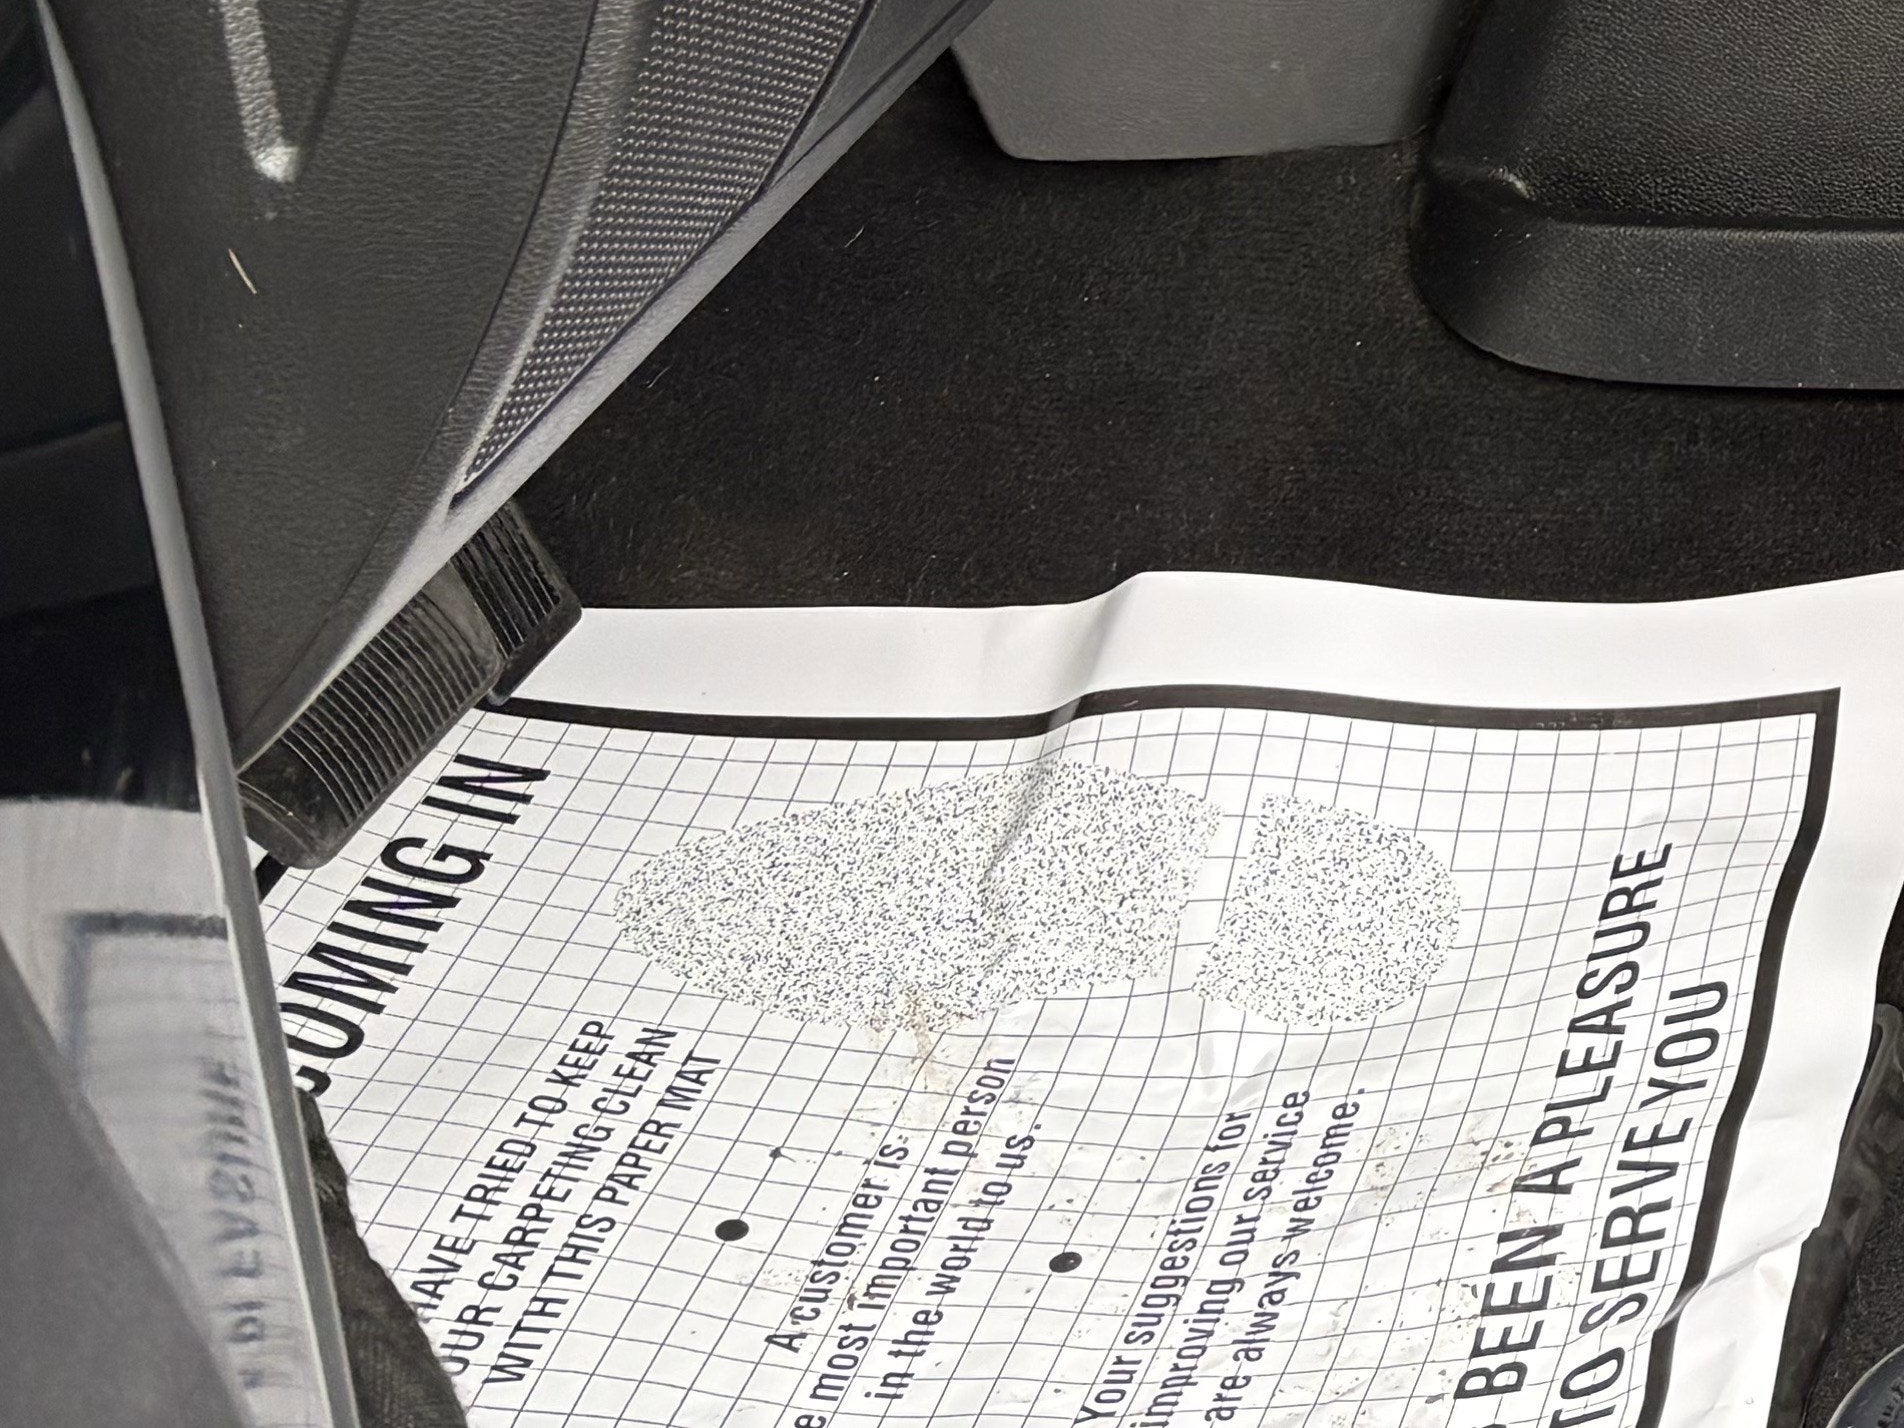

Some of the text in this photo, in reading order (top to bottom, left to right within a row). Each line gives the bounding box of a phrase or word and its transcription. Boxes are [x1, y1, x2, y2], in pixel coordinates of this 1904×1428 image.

[421, 754, 551, 825] IN
[449, 1134, 537, 1225] TRIED
[514, 1092, 569, 1143] TO
[546, 1019, 611, 1088] KEEP
[478, 1122, 613, 1291] CARPETING
[590, 1027, 678, 1116] CLEAN
[481, 1050, 722, 1384] WITH THIS PAPER MAT
[764, 1330, 808, 1353] A
[790, 1178, 890, 1326] customer
[809, 1322, 877, 1402] most
[857, 1166, 962, 1310] important
[941, 1056, 1016, 1158] person
[864, 1123, 1043, 1400] in the world to us.
[1074, 1112, 1251, 1424] Your suggestions for
[1130, 1091, 1310, 1428] improving our service
[1204, 1088, 1365, 1422] are always welcome.
[1453, 842, 1673, 1400] BEEN A PLEASURE
[1549, 980, 1729, 1428] TO SERVE YOU
